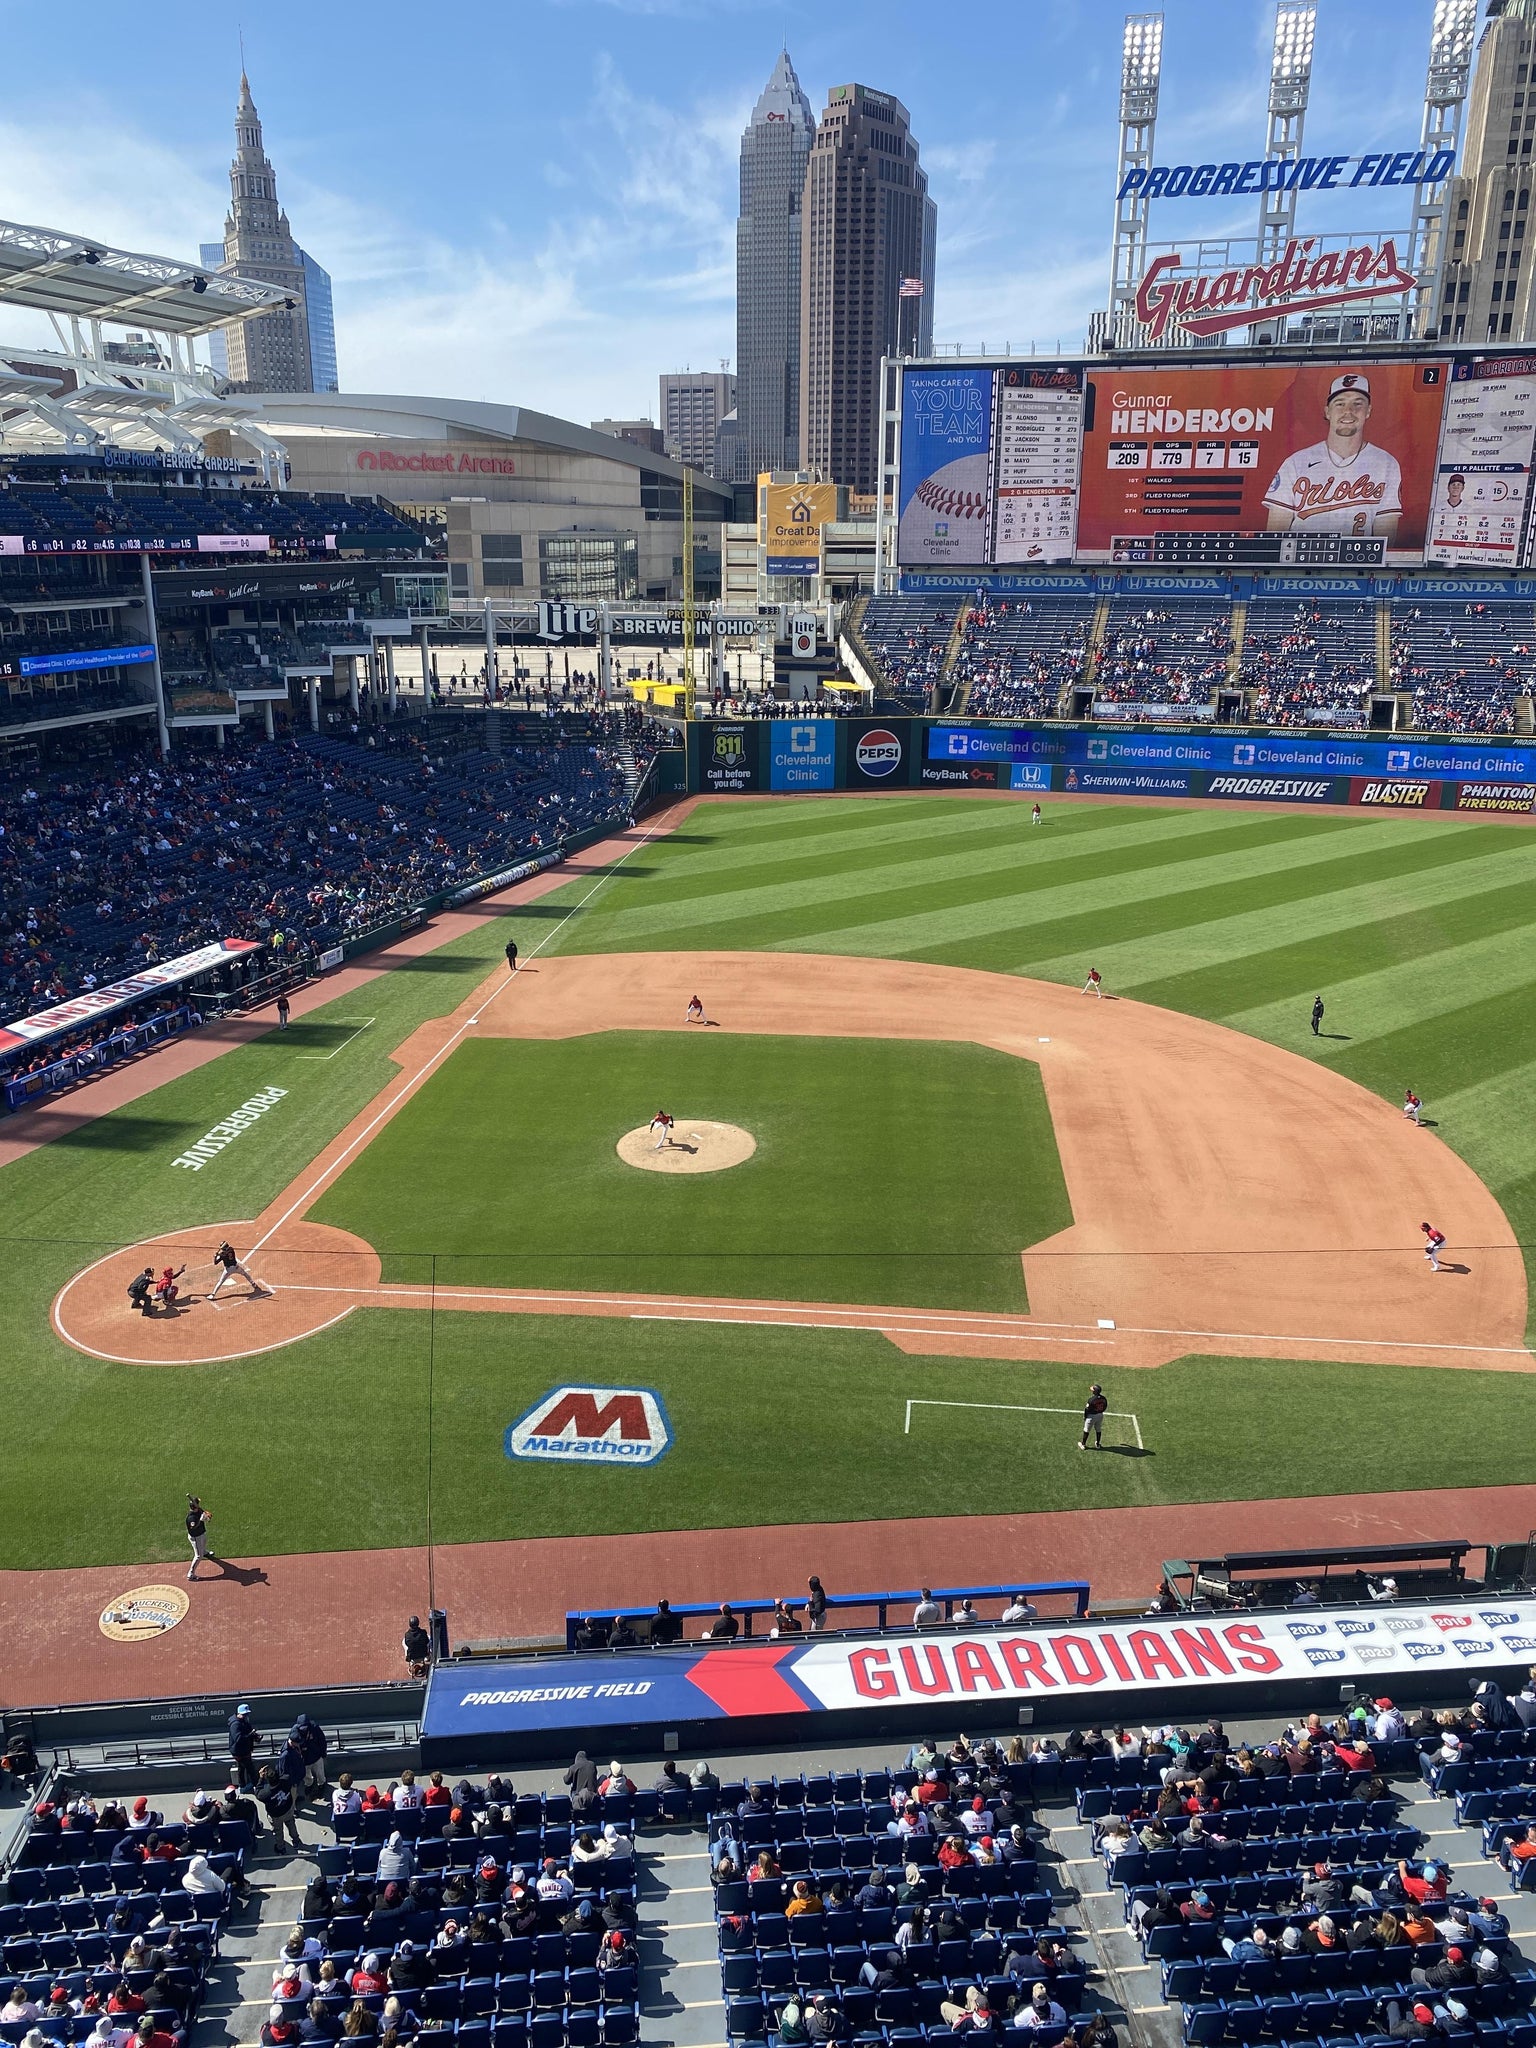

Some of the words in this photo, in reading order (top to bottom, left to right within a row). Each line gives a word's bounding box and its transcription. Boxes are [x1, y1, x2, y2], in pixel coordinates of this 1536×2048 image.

[1116, 156, 1351, 200] PROGRESSIVE
[1348, 150, 1457, 188] FIELD
[1135, 237, 1418, 342] Guardians
[1428, 371, 1434, 382] 2
[942, 379, 961, 387] CARE
[911, 389, 983, 411] YOUR
[1112, 391, 1172, 408] Gunnar
[915, 413, 984, 436] TEAM
[1111, 407, 1274, 434] HENDERSON
[131, 451, 158, 467] MOON
[204, 456, 241, 472] GARDEN
[379, 450, 455, 472] Rocket
[458, 453, 515, 474] Arena
[1115, 453, 1140, 465] .209
[1159, 453, 1182, 465] .779
[1206, 453, 1214, 464] 7
[1238, 452, 1251, 464] 15
[1292, 473, 1387, 512] Orioles
[1493, 487, 1502, 495] 15
[1352, 512, 1367, 536] 2
[775, 525, 804, 536] Great
[31, 541, 37, 550] 6
[53, 541, 64, 550] 0-1
[76, 540, 87, 550] 8.2
[101, 540, 115, 550] 4.15
[153, 539, 165, 549] 3.12
[180, 538, 191, 548] 1.15
[240, 538, 250, 548] 0-0
[923, 538, 959, 547] Cleveland
[1354, 543, 1361, 551] 0
[1373, 543, 1380, 551] 0
[930, 547, 951, 555] Clinic
[1132, 552, 1146, 560] CLE
[300, 583, 318, 592] KeyBank
[924, 576, 994, 587] HONDA
[1015, 577, 1087, 588] HONDA
[1144, 578, 1220, 589] HONDA
[1282, 579, 1361, 591] HONDA
[1424, 582, 1507, 593] HONDA
[191, 588, 214, 599] KeyBank
[534, 600, 598, 641] Lite
[696, 620, 712, 635] IN
[716, 620, 754, 635] OHIO
[795, 621, 815, 634] Lite
[3, 663, 12, 674] 15
[1042, 722, 1079, 730] PROGRESSIVE
[1153, 726, 1192, 734] PROGRESSIVE
[1209, 728, 1250, 736] PROGRESSIVE
[1268, 729, 1309, 738] PROGRESSIVE
[1327, 732, 1369, 740] PROGRESSIVE
[1387, 734, 1430, 742] PROGRESSIVE
[715, 734, 741, 755] 811
[971, 739, 1029, 753] Cleveland
[1031, 741, 1066, 754] Clinic
[1449, 736, 1494, 745] PROGRESSIVE
[858, 747, 899, 759] PEPSI
[1110, 744, 1172, 758] Cleveland
[1175, 747, 1212, 760] Clinic
[1258, 750, 1323, 765] Cleveland
[1325, 752, 1364, 766] Clinic
[775, 754, 831, 766] Cleveland
[1413, 756, 1483, 770] Cleveland
[1484, 759, 1525, 772] Clinic
[707, 769, 722, 779] Call
[725, 769, 751, 779] before
[786, 769, 819, 781] Clinic
[922, 769, 969, 781] KeyBank
[714, 780, 729, 790] you
[729, 779, 745, 789] dig.
[1208, 777, 1331, 798] PROGRESSIVE
[1360, 782, 1429, 805] BLASTER
[1461, 784, 1536, 800] PHANTOM
[1458, 797, 1533, 811] FIREWORKS
[24, 974, 168, 1029] CLEVELAND
[170, 1085, 290, 1172] PROGRESSIVE
[529, 1393, 651, 1441] M
[521, 1438, 652, 1457] Marathon
[1289, 1625, 1321, 1636] 2001
[1338, 1622, 1372, 1633] 2007
[1388, 1620, 1418, 1631] 2013
[1434, 1616, 1465, 1628] 2016
[1483, 1614, 1514, 1626] 2017
[1307, 1650, 1341, 1661] 2018
[1358, 1647, 1391, 1659] 2020
[1407, 1644, 1442, 1655] 2022
[1457, 1641, 1489, 1653] 2024
[848, 1622, 1284, 1700] GUARDIANS
[460, 1685, 594, 1706] PROGRESSIVE
[593, 1681, 652, 1698] FIELD
[150, 1713, 184, 1721] ACCESSIBLE
